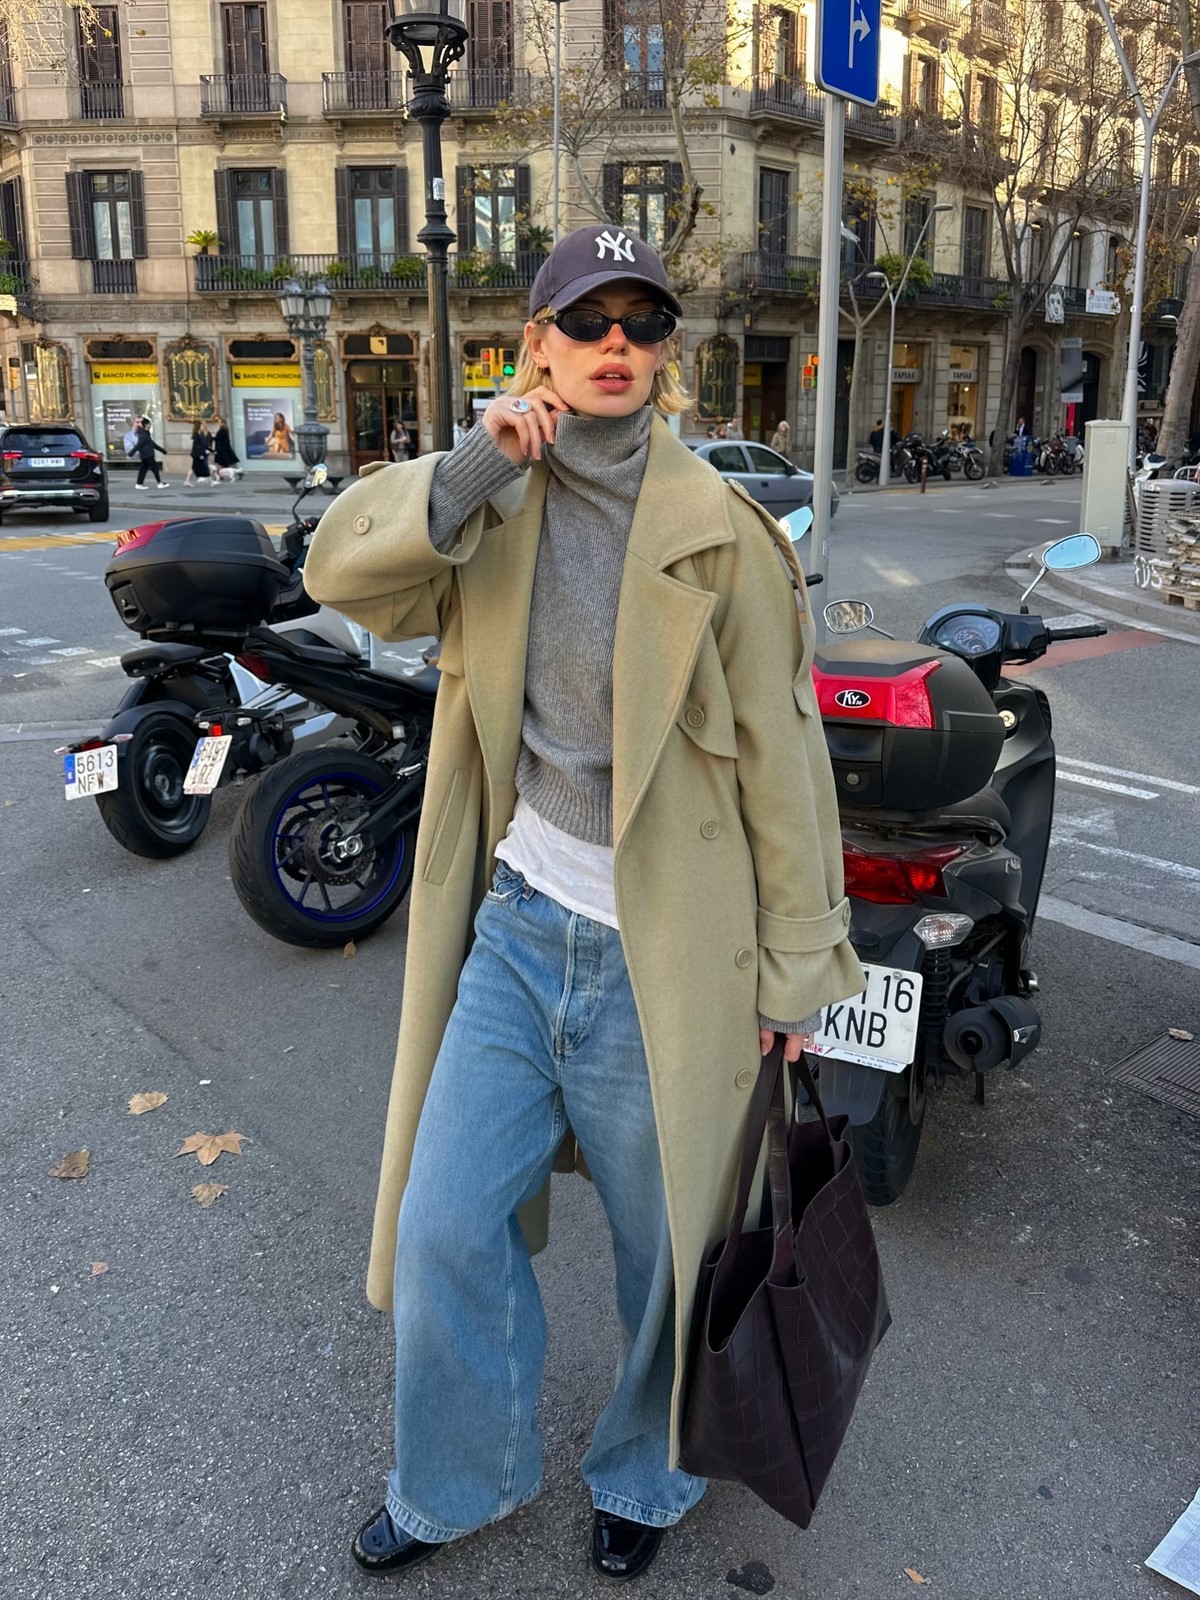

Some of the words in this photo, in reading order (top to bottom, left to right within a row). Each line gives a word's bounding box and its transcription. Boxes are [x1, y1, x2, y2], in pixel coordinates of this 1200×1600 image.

[595, 230, 636, 263] NY
[893, 371, 916, 380] TAPIAS
[952, 371, 973, 380] TAPIAS
[77, 750, 114, 775] 5613
[77, 770, 105, 795] NFW
[823, 1003, 888, 1049] KNB
